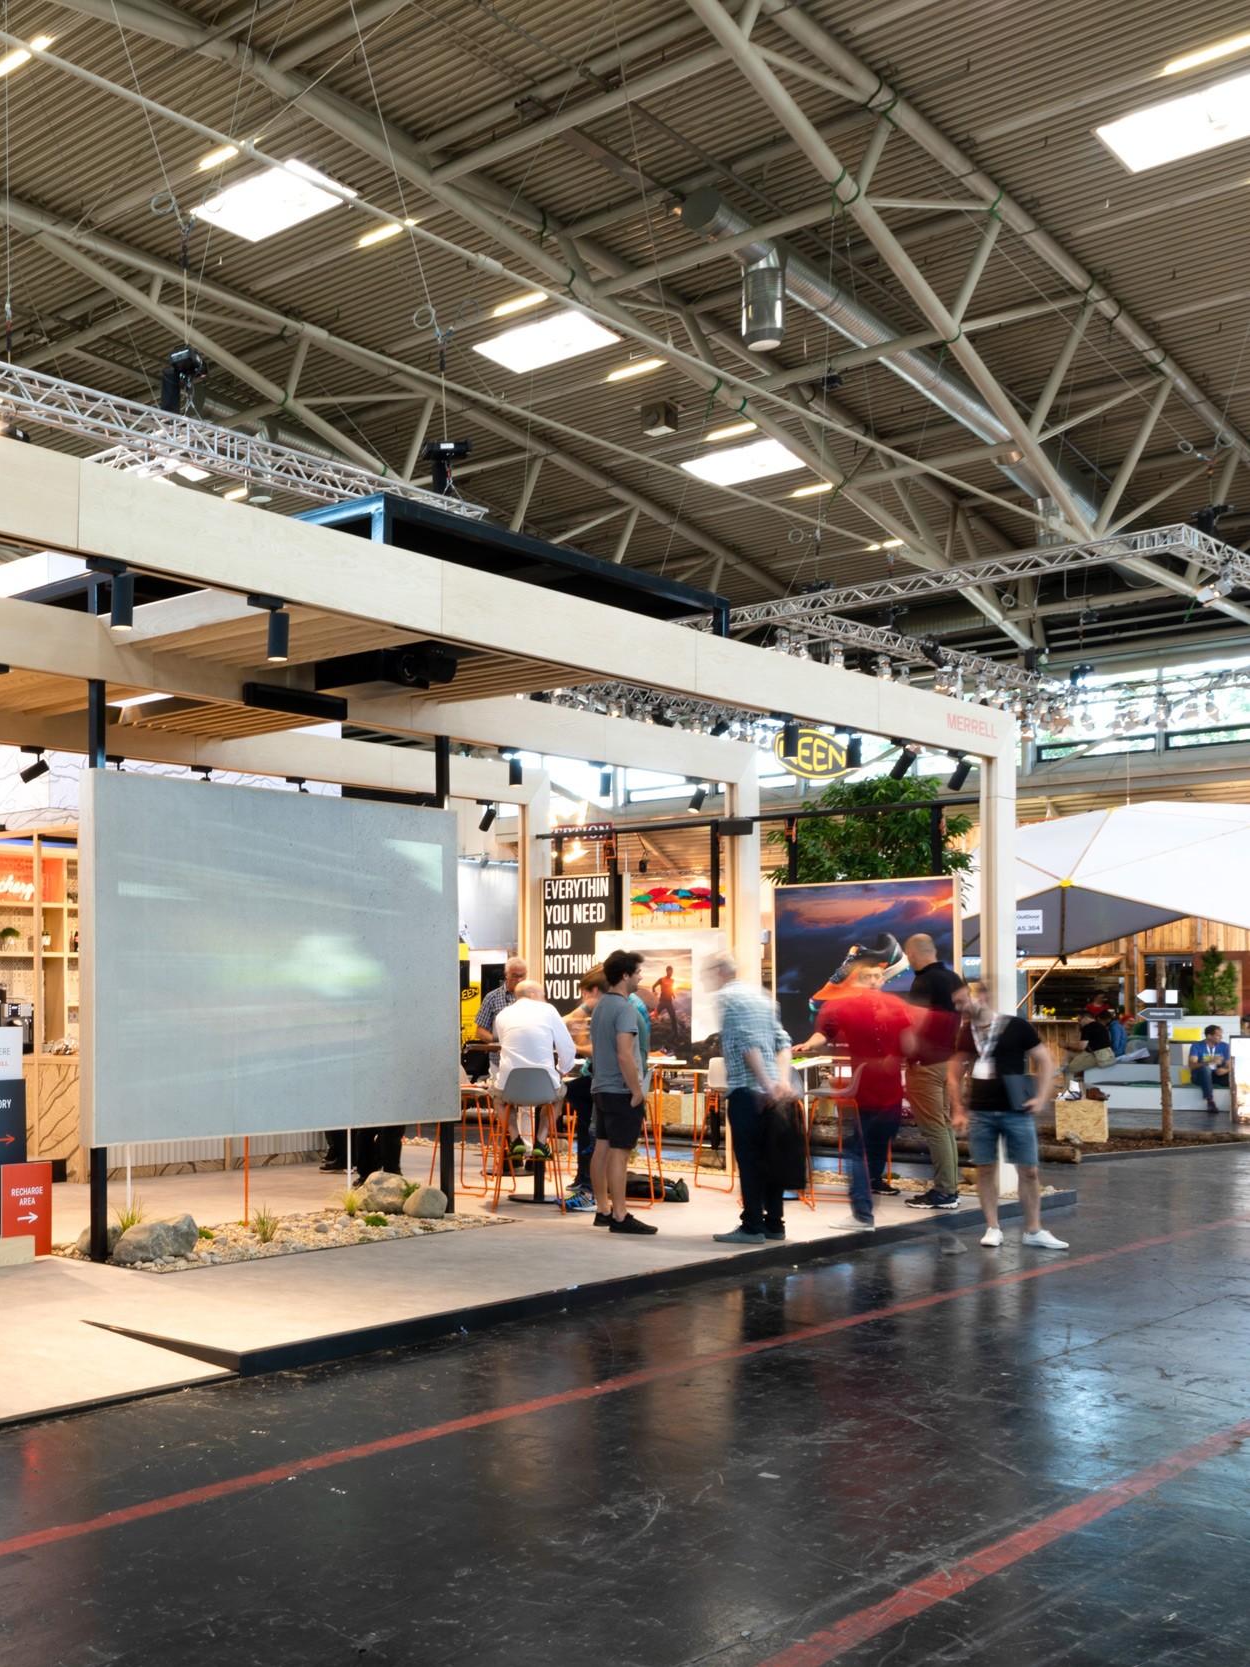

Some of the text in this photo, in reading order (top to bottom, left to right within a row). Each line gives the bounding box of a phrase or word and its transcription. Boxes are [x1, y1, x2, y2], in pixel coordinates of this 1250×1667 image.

[947, 712, 997, 739] MERRELL
[544, 876, 610, 900] EVERYTHIN
[545, 902, 606, 925] YOU NEED
[545, 929, 572, 950] AND
[461, 987, 479, 1000] EEN
[546, 979, 570, 1000] YOU
[11, 1185, 44, 1197] RECHARGE
[18, 1196, 36, 1207] AREA
